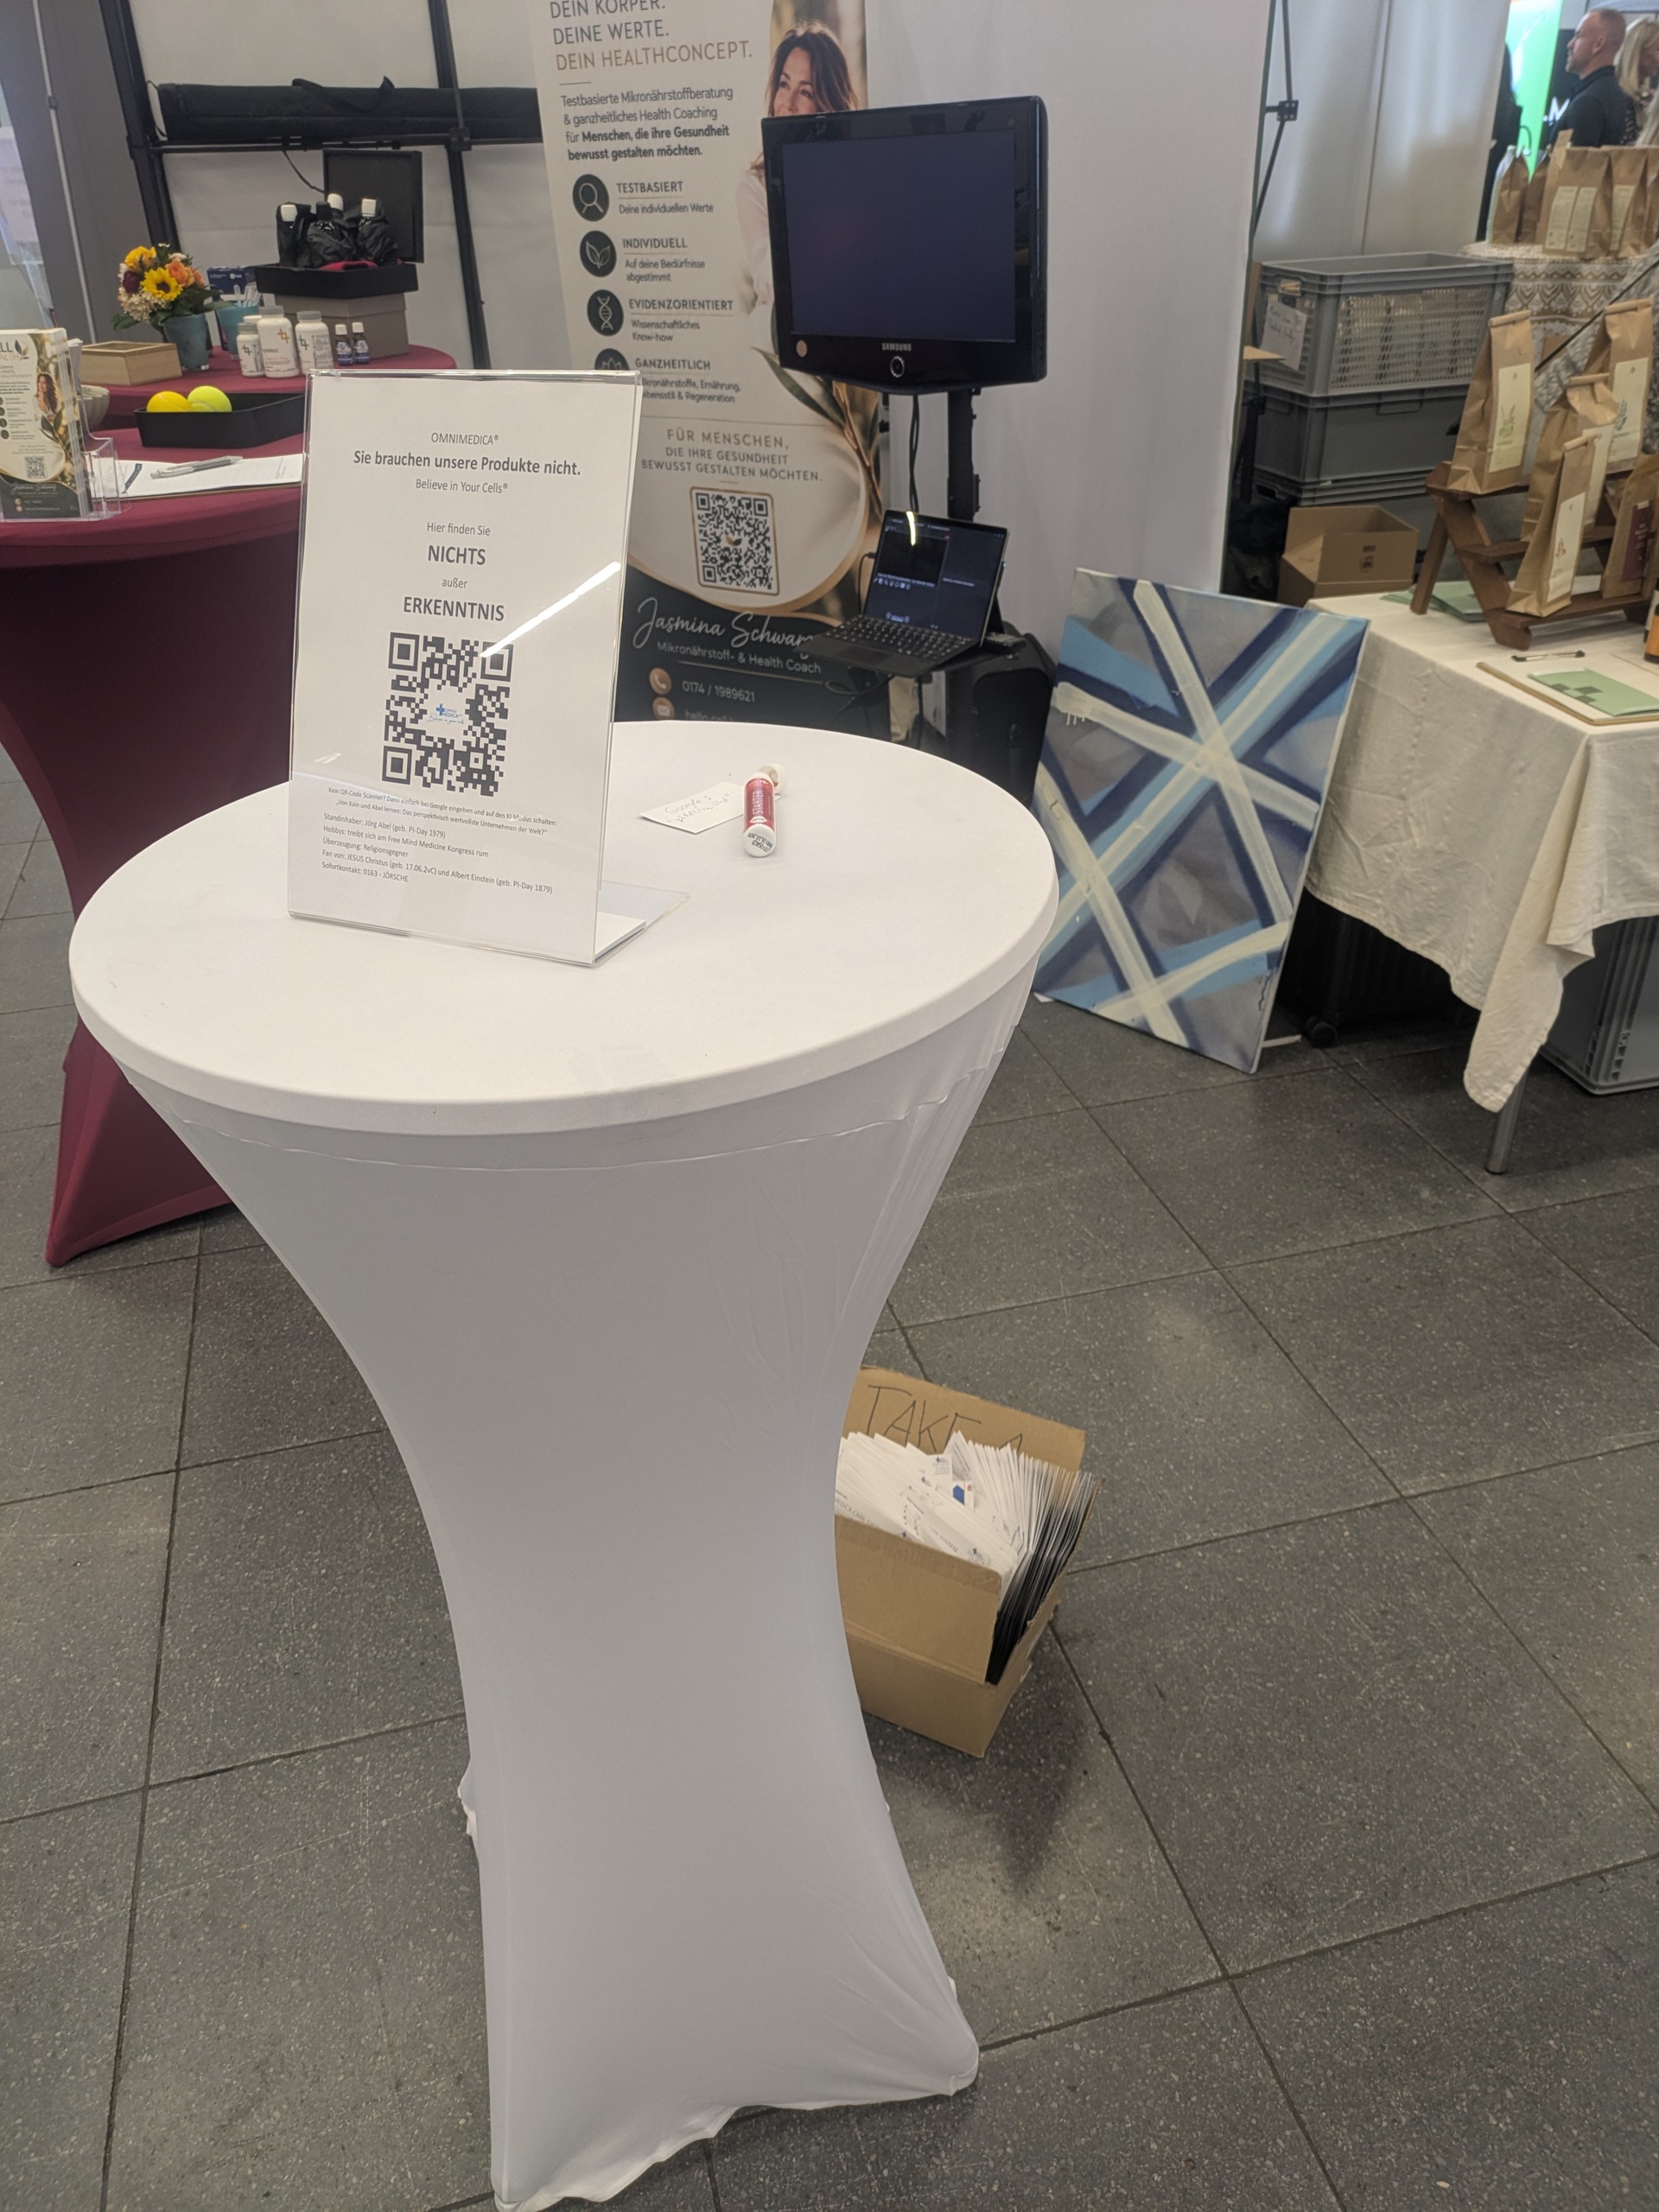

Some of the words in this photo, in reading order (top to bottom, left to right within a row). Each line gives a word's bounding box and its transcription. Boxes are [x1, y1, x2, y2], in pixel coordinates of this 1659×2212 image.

[550, 0, 588, 18] DEIN
[553, 24, 602, 45] DEINE
[607, 19, 670, 40] WERTE.
[556, 52, 595, 71] DEIN
[601, 41, 753, 68] HEALTHCONCEPT.
[561, 93, 620, 107] Testbasierte
[621, 87, 734, 105] Mikronährstoffberatung
[563, 114, 571, 125] &
[574, 110, 638, 127] ganzheitliches
[639, 108, 671, 122] Health
[673, 107, 718, 123] Coaching
[566, 131, 580, 143] für
[582, 130, 633, 143] Menschen,
[635, 127, 649, 140] die
[652, 126, 671, 139] ihre
[673, 124, 730, 139] Gesundheit
[568, 149, 609, 161] bewusst
[612, 146, 654, 162] gestalten
[657, 144, 702, 158] möchten.
[616, 181, 683, 194] TESTBASIERT
[619, 204, 639, 214] Deine
[641, 202, 689, 213] individuellen
[690, 203, 714, 213] Werte
[623, 238, 688, 249] INDIVIDUELL
[626, 260, 638, 270] Auf
[639, 260, 659, 269] deine
[661, 259, 705, 269] Bedürfnisse
[626, 273, 671, 284] abgestimmt
[629, 299, 734, 311] EVIDENZORIENTIERT
[631, 319, 700, 330] Wissenschaftliches
[632, 333, 673, 342] Know-how
[881, 342, 912, 352] SAMSUNG
[635, 358, 711, 371] GANZHEITLICH
[677, 391, 683, 400] &
[686, 391, 735, 404] Regeneration
[667, 427, 695, 442] FÜR
[702, 432, 789, 448] MENSCHEN,
[353, 450, 372, 464] Sie
[375, 452, 430, 467] brauchen
[435, 456, 478, 470] unsere
[481, 456, 540, 473] Produkte
[543, 461, 581, 475] nicht.
[665, 448, 683, 458] DIE
[688, 448, 712, 460] IHRE
[716, 450, 788, 466] GESUNDHEIT
[641, 460, 692, 472] BEWUSST
[696, 463, 755, 477] GESTALTEN
[760, 466, 823, 481] MÖCHTEN.
[416, 478, 448, 491] Believe
[450, 480, 458, 491] in
[461, 481, 480, 493] Your
[427, 522, 445, 533] Hier
[448, 523, 475, 536] finden
[477, 525, 491, 536] Sie
[428, 544, 486, 565] NICHTS
[442, 577, 467, 589] außer
[404, 596, 505, 621] ERKENNTNIS
[632, 597, 726, 649] Jasmina
[730, 611, 814, 650] Schwar
[658, 641, 734, 660] Mikronährstoff-
[739, 652, 746, 664] &
[749, 654, 783, 669] Health
[786, 658, 822, 674] Coach
[682, 680, 705, 695] 0174
[708, 684, 712, 696] /
[715, 685, 755, 702] 1989621
[340, 788, 362, 798] QR-Code
[363, 791, 386, 801] Scanner?
[386, 795, 400, 804] Dann
[429, 802, 448, 810] Google
[448, 805, 473, 814] eingeben
[323, 812, 364, 825] Standinhaber:
[365, 819, 378, 829] Jörg
[378, 821, 391, 830] Abel
[392, 823, 407, 832] (geb.
[429, 830, 446, 839] 1979)
[384, 805, 402, 814] lernen:
[413, 811, 449, 822] perspektivisch
[450, 817, 480, 826] wertvollste
[480, 820, 518, 832] Unternehmen
[322, 836, 363, 851] Überzeugung:
[363, 843, 410, 858] Religionsgegner
[323, 825, 346, 836] Hobbys:
[347, 830, 364, 838] treibt
[365, 831, 377, 840] sich
[388, 835, 401, 844] Free
[402, 837, 418, 847] Mind
[419, 840, 447, 851] Medicine
[447, 845, 475, 855] Kongress
[476, 849, 489, 858] rum
[321, 861, 363, 874] Sofortkontakt:
[363, 868, 378, 877] 0163
[382, 871, 409, 882] JÖRSCHE
[322, 849, 333, 857] Fan
[346, 853, 365, 862] JESUS
[365, 856, 388, 867] Christus
[389, 860, 404, 869] (geb.
[438, 868, 450, 877] und
[451, 870, 470, 880] Albert
[471, 874, 495, 884] Einstein
[496, 877, 512, 887] (geb.
[534, 884, 553, 895] 1879)
